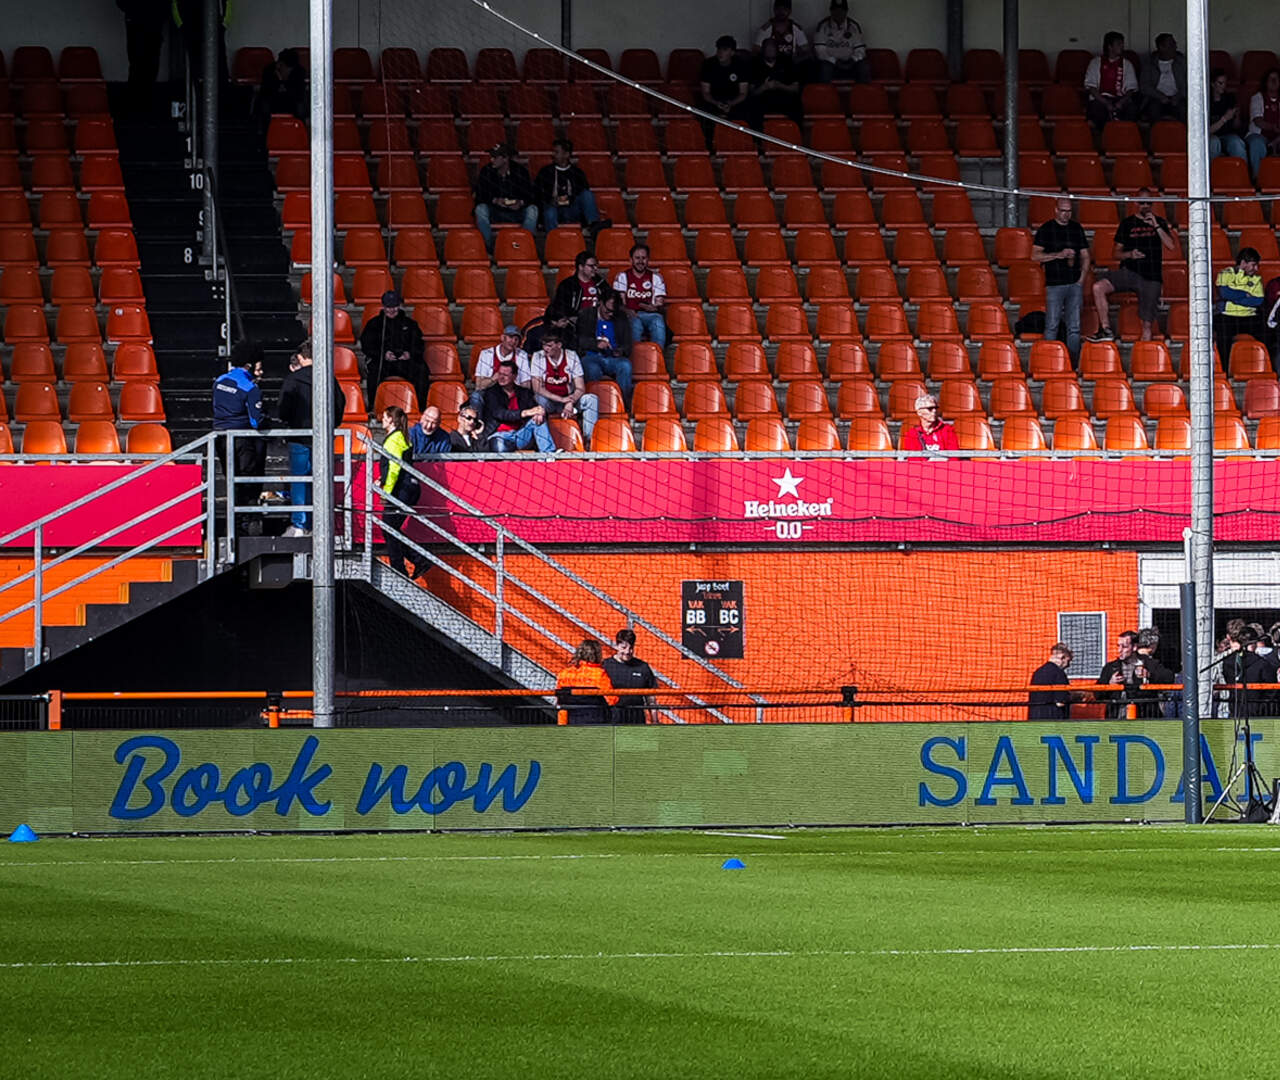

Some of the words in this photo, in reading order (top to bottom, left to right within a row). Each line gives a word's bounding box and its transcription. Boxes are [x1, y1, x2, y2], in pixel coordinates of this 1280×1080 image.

[190, 174, 203, 189] 10
[184, 248, 192, 263] 8
[744, 499, 833, 517] Heineken
[686, 610, 706, 624] BB
[720, 610, 739, 624] BC
[109, 735, 332, 820] Book
[356, 759, 542, 814] now
